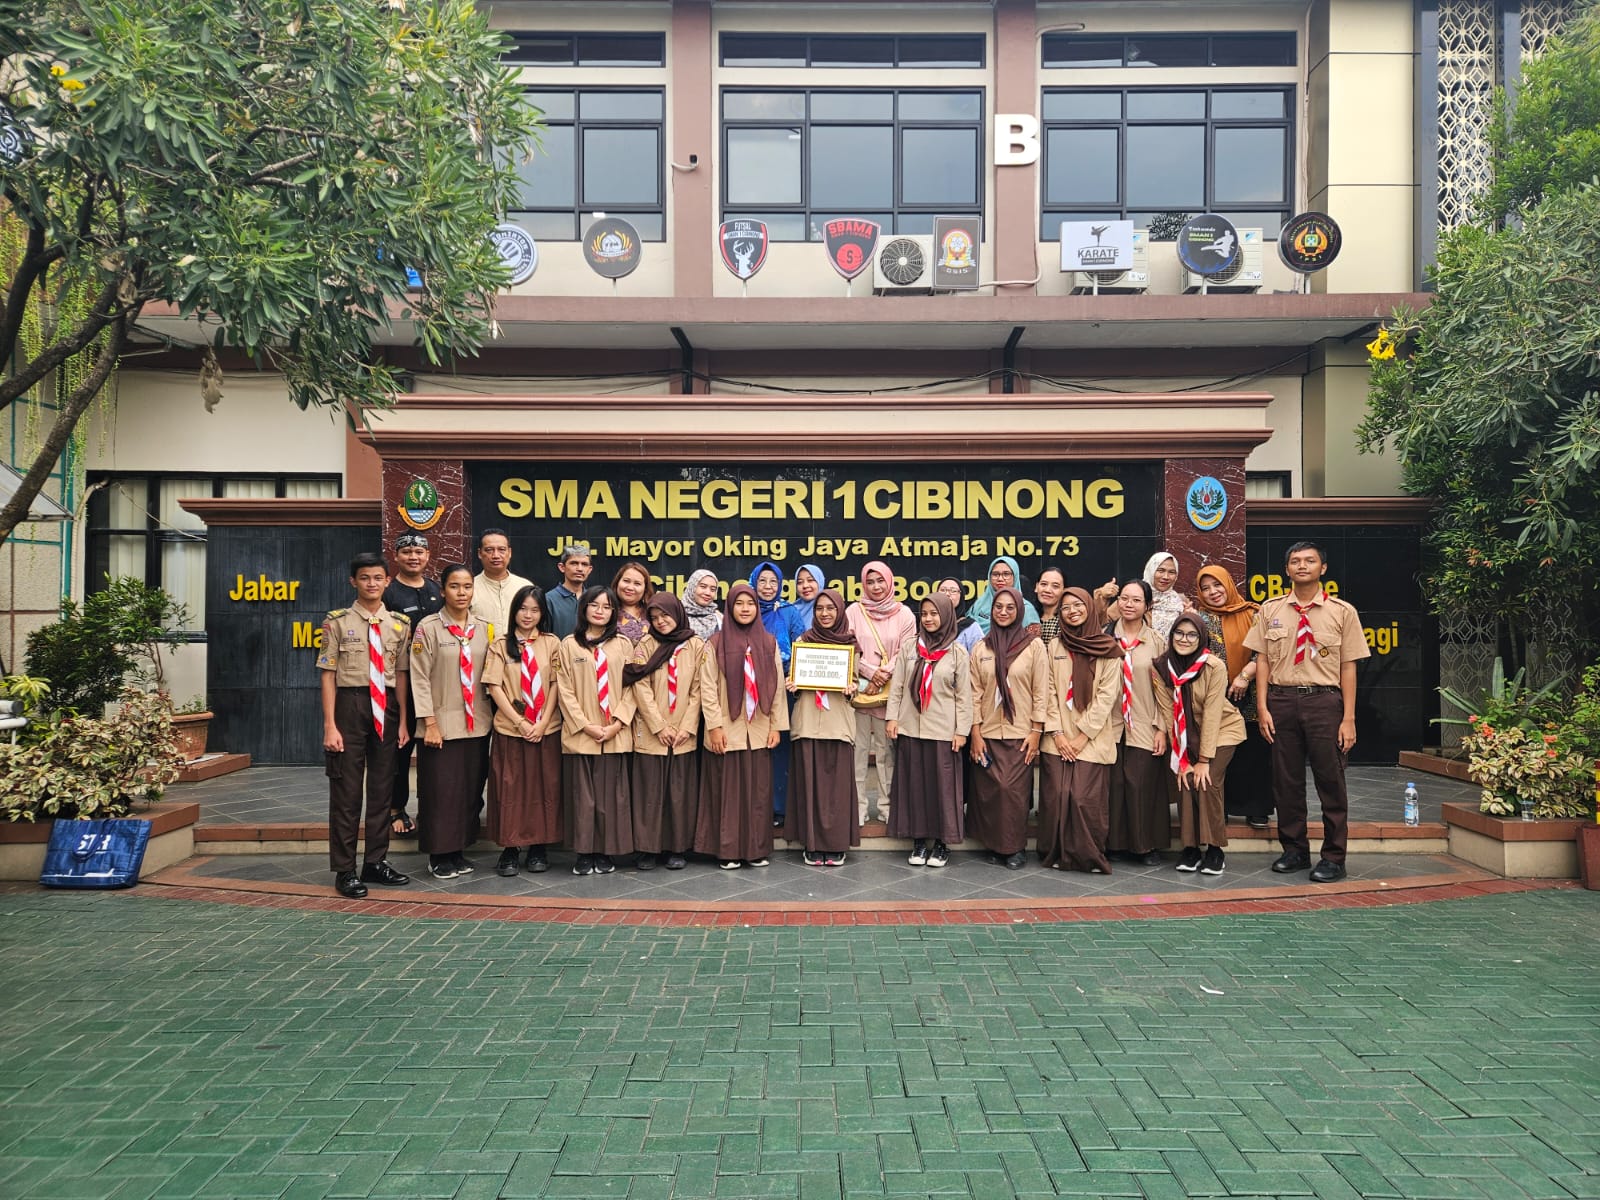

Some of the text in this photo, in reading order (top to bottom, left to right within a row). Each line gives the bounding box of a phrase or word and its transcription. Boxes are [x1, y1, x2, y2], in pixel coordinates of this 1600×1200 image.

[994, 113, 1040, 165] B
[828, 221, 873, 237] SBAMA
[1078, 248, 1120, 258] KARATE
[498, 479, 1124, 519] SMA NEGERI 1 CIBINONG
[607, 537, 694, 560] Mayor
[704, 536, 786, 560] Oking
[800, 537, 868, 560] Jaya
[880, 536, 987, 560] Atmaja
[230, 574, 300, 600] Jabar
[893, 576, 989, 602] Boor
